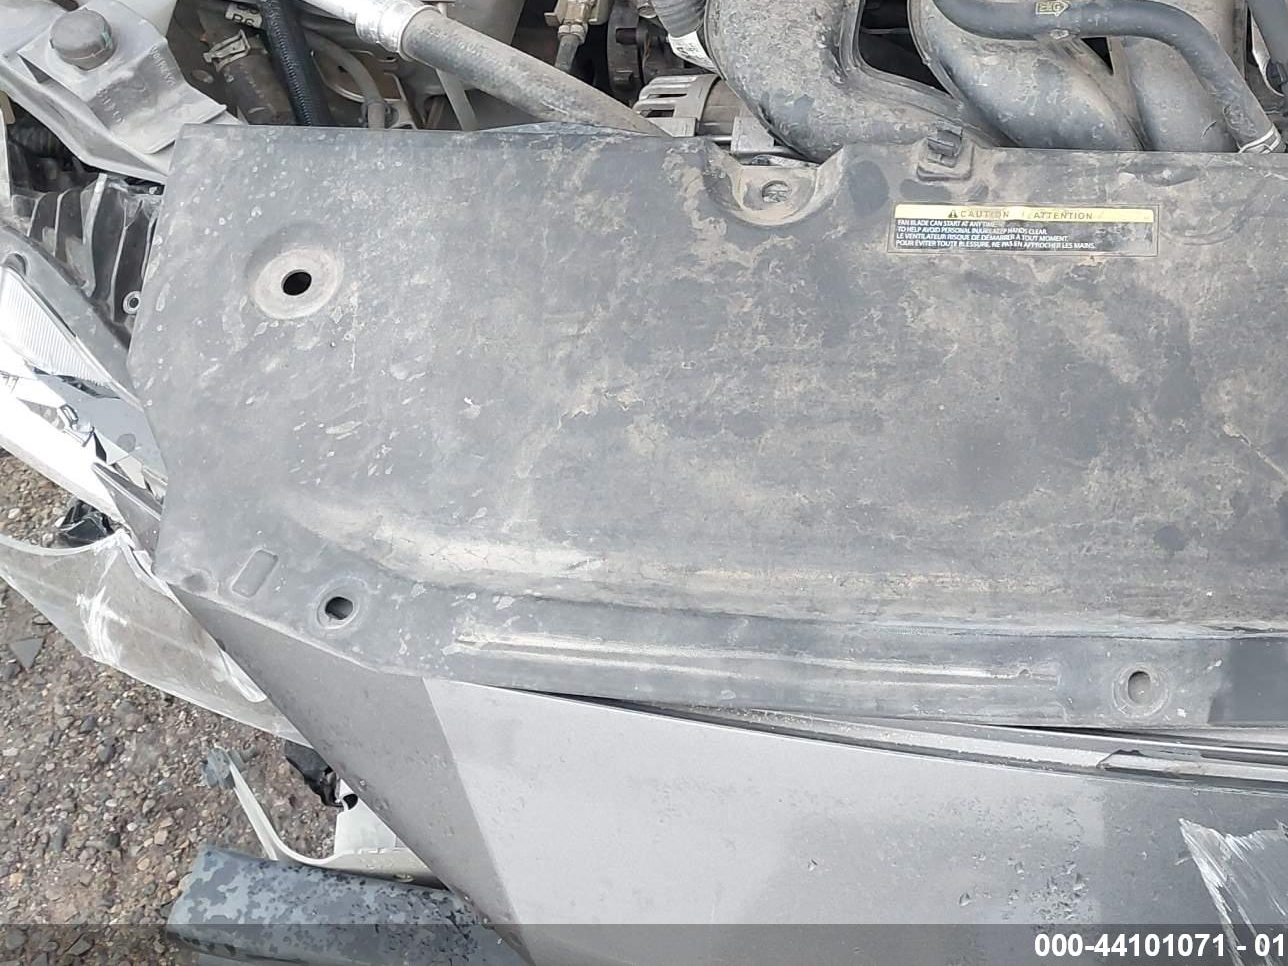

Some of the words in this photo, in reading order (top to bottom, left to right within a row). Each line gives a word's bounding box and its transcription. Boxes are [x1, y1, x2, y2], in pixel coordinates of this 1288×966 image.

[960, 209, 1009, 219] CAUTION
[1033, 211, 1093, 221] ATTENTION
[922, 226, 941, 234] AVOID
[1008, 227, 1028, 235] HANDS
[904, 233, 947, 241] VENTILATEUR
[1023, 241, 1061, 249] APPROCHER
